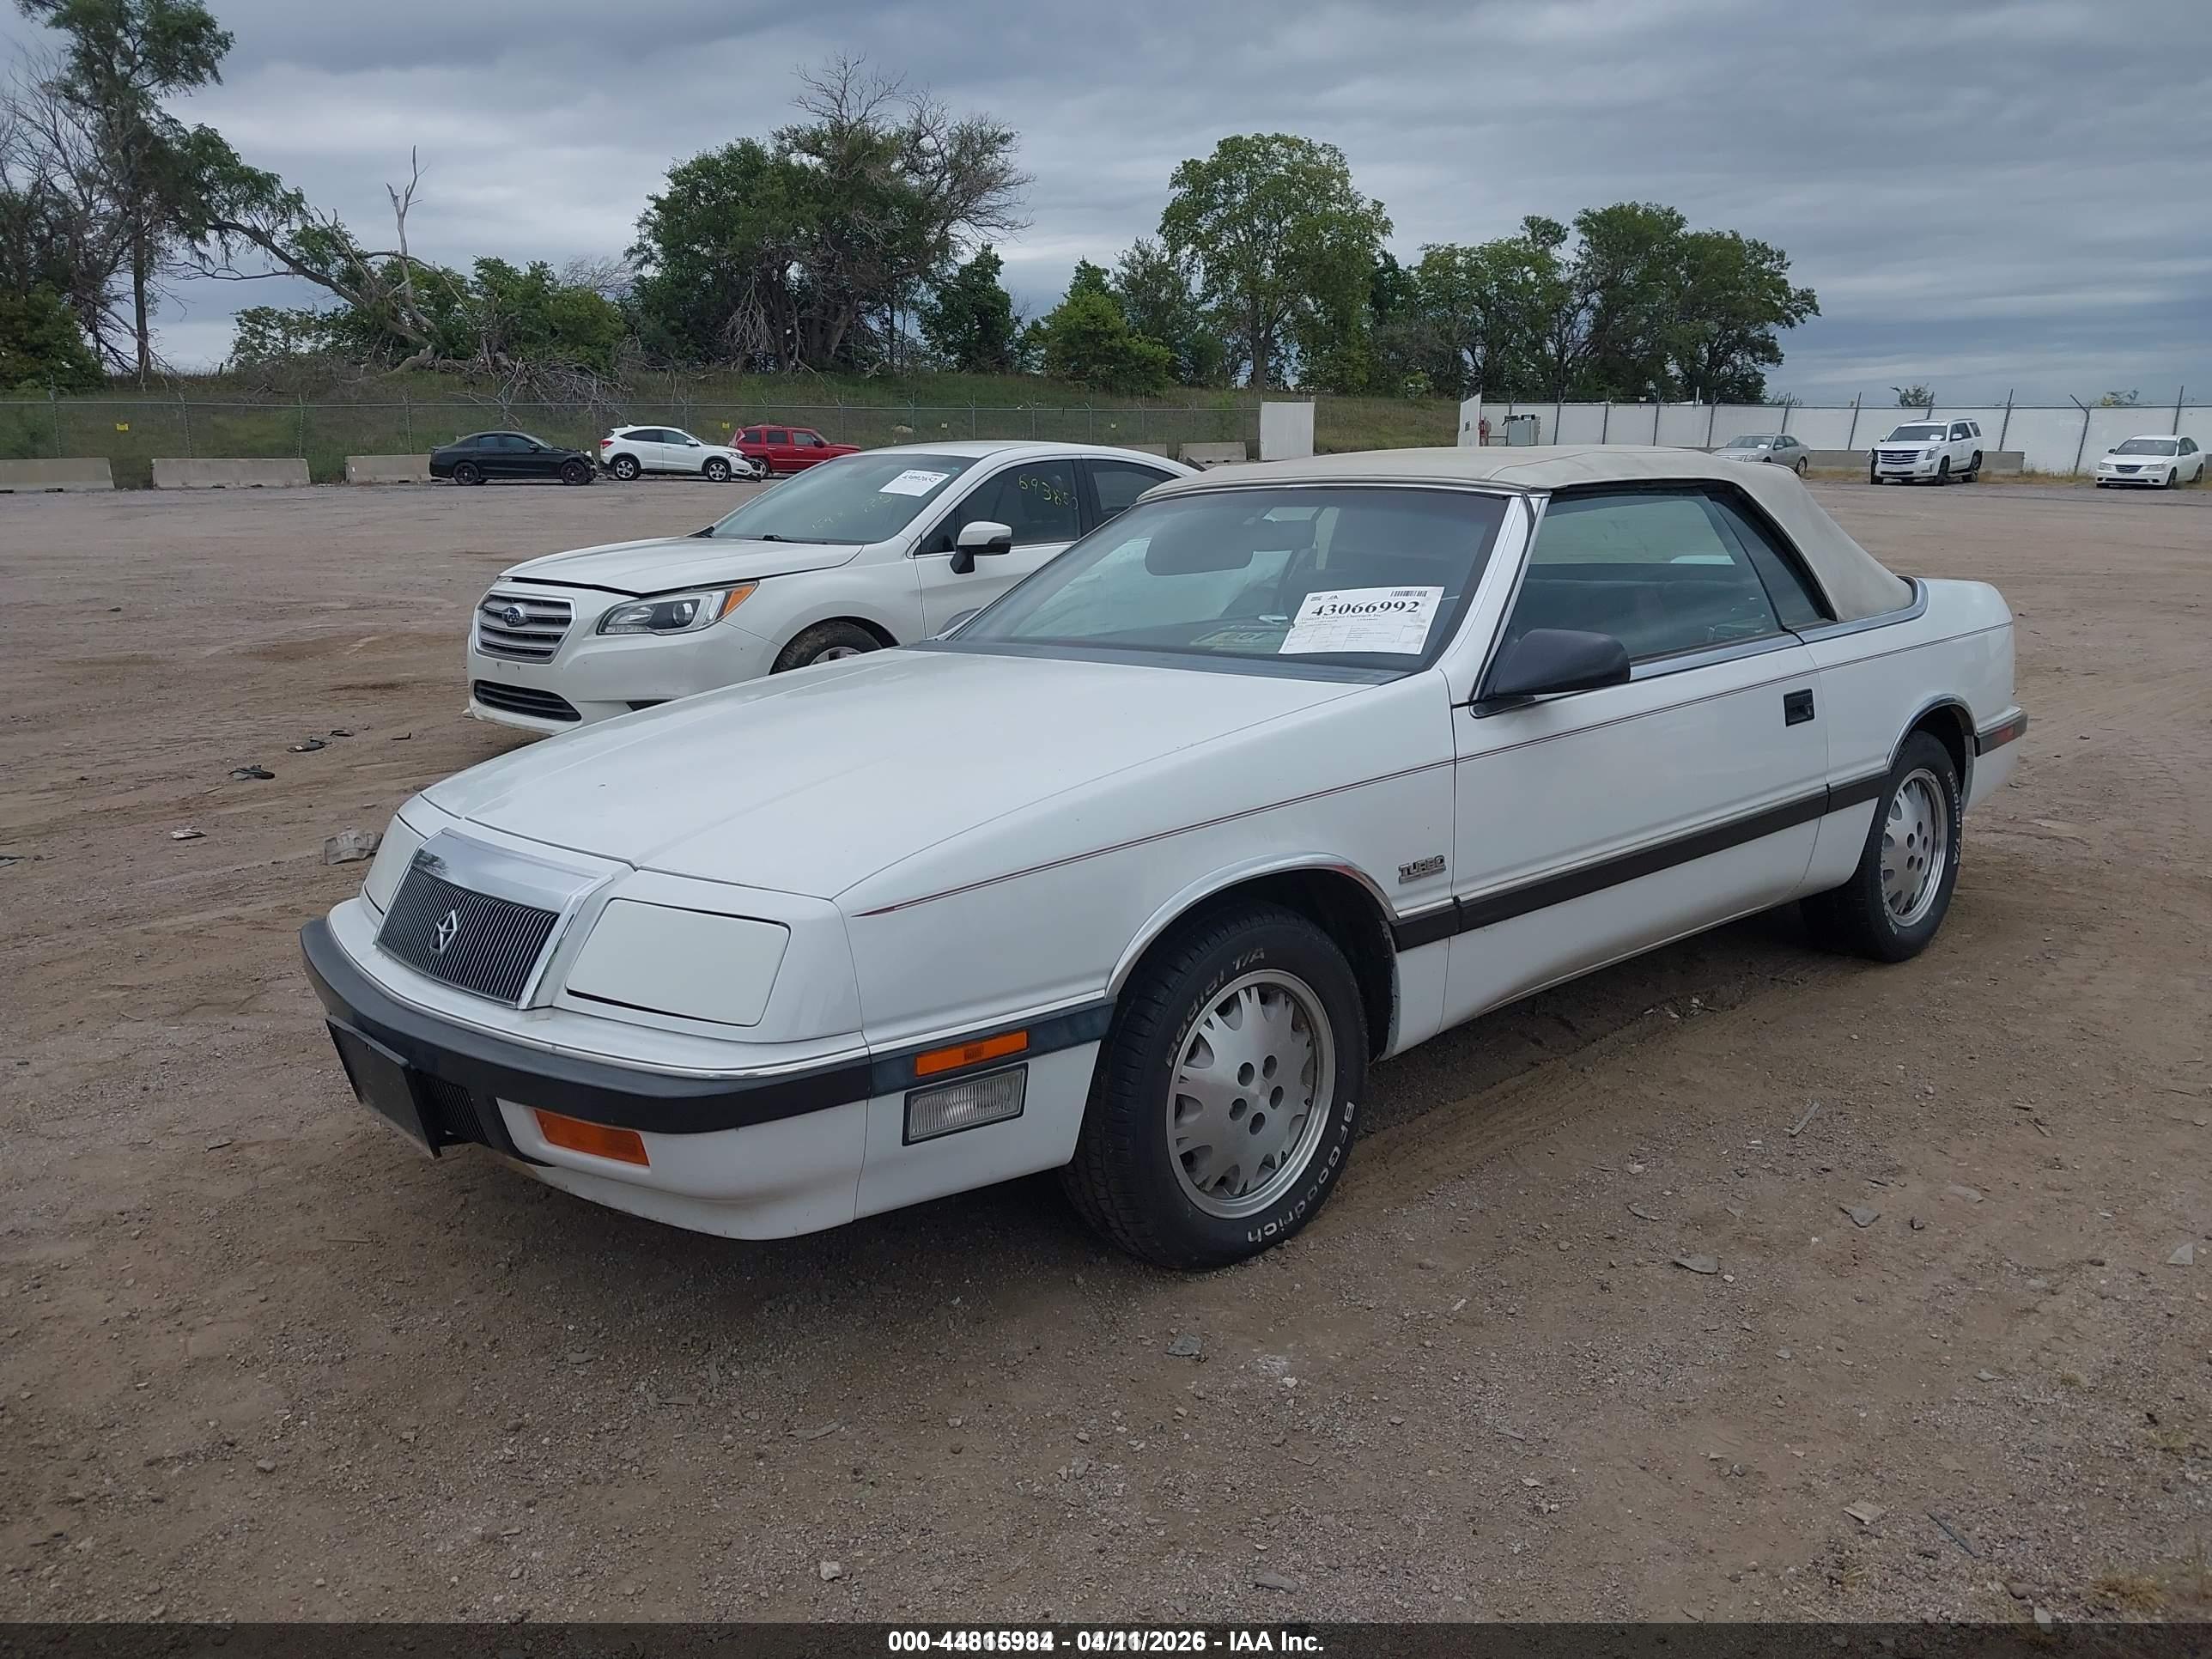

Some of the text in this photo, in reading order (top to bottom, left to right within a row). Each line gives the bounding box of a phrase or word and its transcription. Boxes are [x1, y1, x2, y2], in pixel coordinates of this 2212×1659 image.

[1311, 601, 1419, 616] 43066992
[1399, 854, 1446, 879] TURBO
[1232, 947, 1265, 970] T/A
